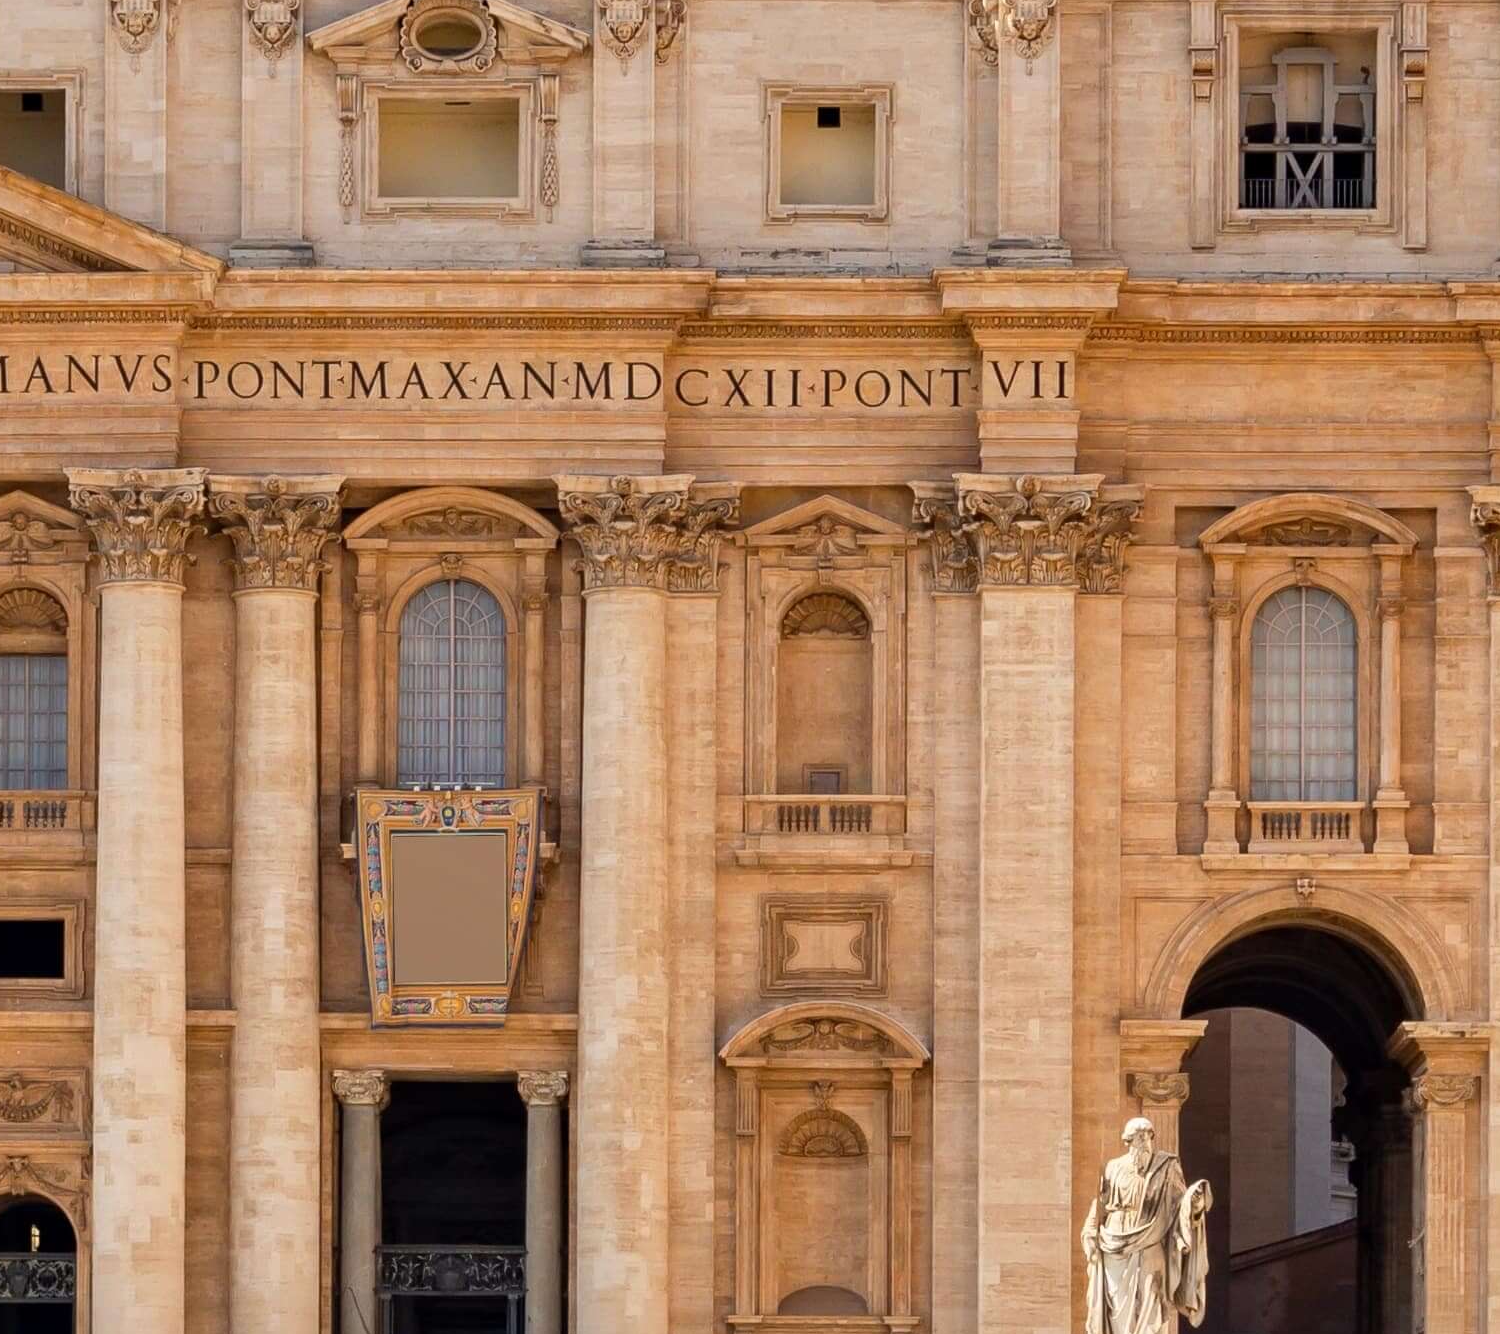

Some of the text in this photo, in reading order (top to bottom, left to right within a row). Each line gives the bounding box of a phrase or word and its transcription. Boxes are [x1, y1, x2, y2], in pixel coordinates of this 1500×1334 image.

[193, 359, 342, 399] PONT
[346, 360, 471, 400] MAX
[481, 361, 558, 400] AN
[571, 361, 801, 407] MDCXII
[820, 367, 972, 408] PONT
[990, 360, 1069, 399] VII
